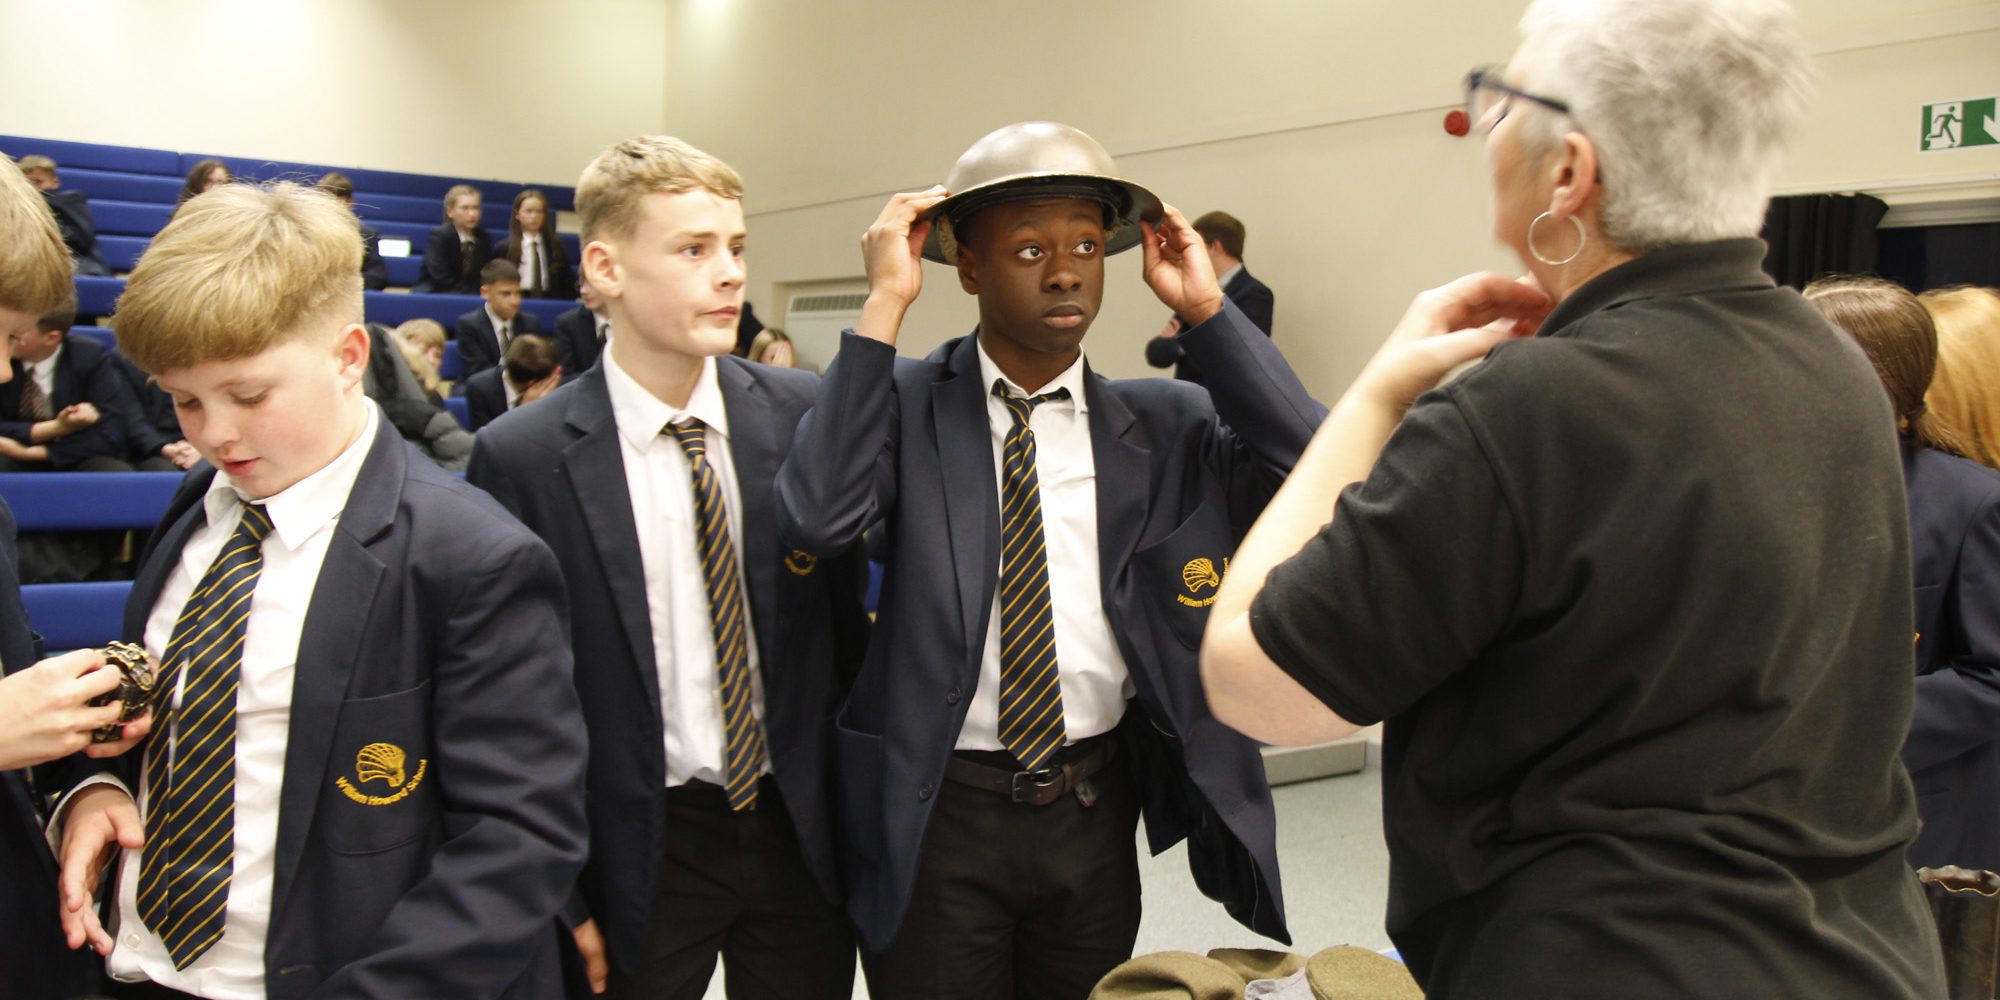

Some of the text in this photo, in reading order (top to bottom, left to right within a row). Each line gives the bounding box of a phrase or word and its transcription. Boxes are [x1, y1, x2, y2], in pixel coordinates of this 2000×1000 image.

[1177, 594, 1218, 608] William How
[335, 759, 428, 806] William Howard School
